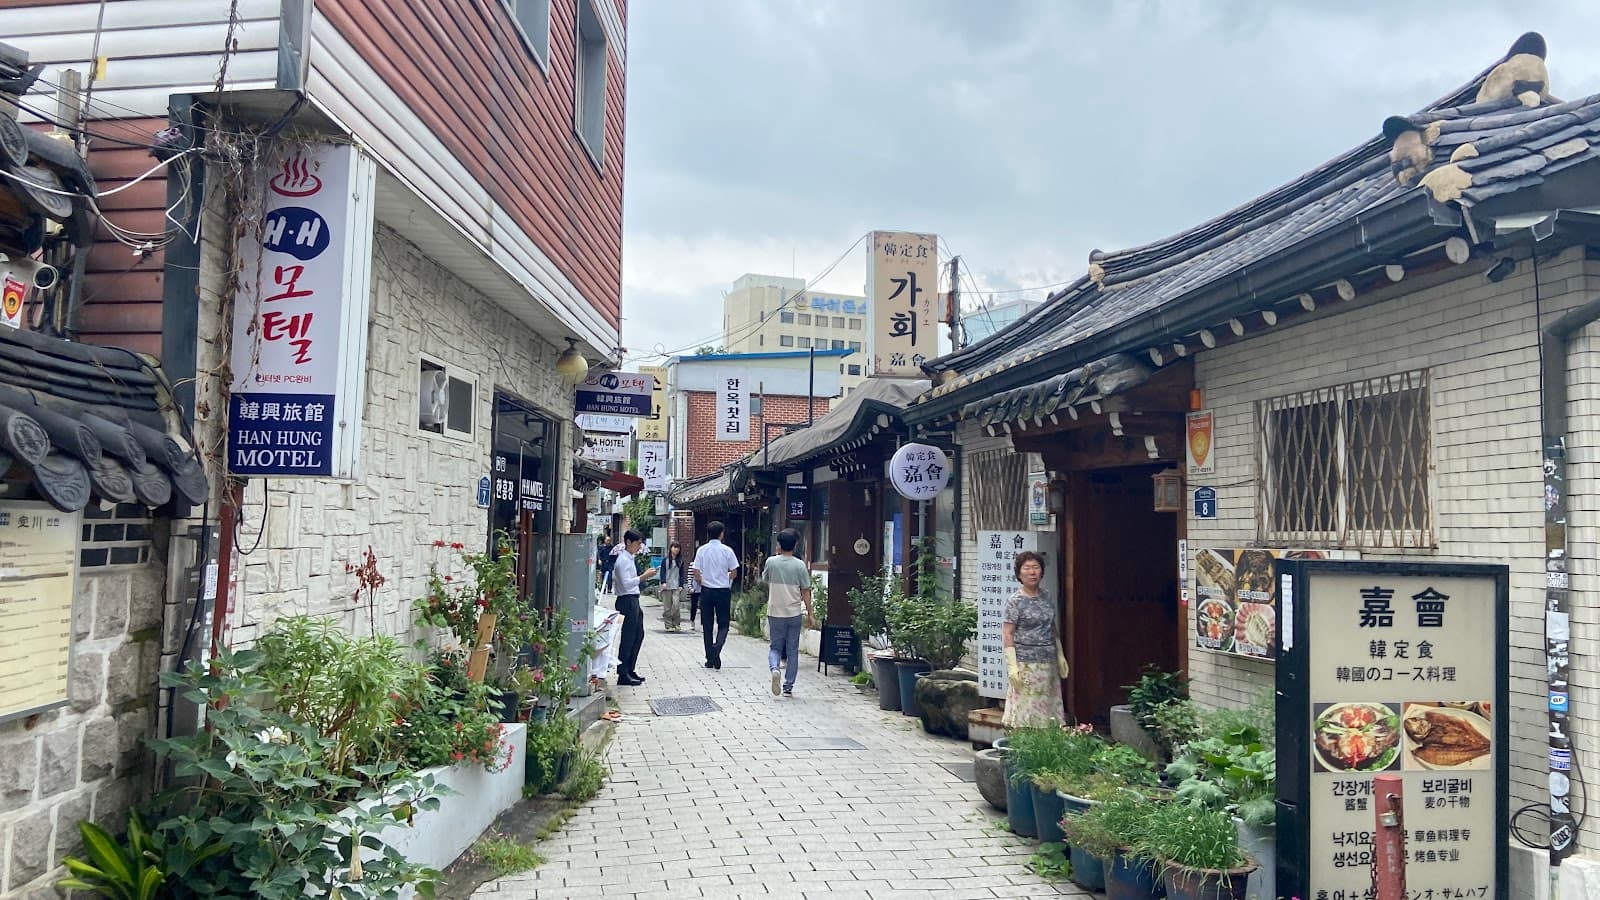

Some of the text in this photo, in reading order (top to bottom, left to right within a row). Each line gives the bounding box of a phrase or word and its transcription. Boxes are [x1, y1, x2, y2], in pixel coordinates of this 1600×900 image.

[263, 265, 314, 365] 모텔
[888, 271, 923, 347] 가회
[620, 378, 645, 392] 모텔
[239, 401, 325, 422] 韓興旅館
[586, 403, 641, 414] HAN HUNG MOTEL
[726, 378, 741, 433] 한옥찻집
[238, 430, 323, 446] HAN HUNG
[599, 438, 625, 448] HOSTEL
[236, 449, 322, 468] MOTEL
[643, 451, 657, 480] 귀천
[900, 463, 944, 484] 嘉會
[1202, 502, 1208, 515] 8
[1359, 586, 1450, 628] 嘉會
[1369, 639, 1434, 659] 韓定食
[1336, 665, 1457, 682] 韓國のコース料理
[1332, 780, 1376, 796] 간장게
[1421, 778, 1472, 794] 보리굴비
[1424, 796, 1470, 809] 麦の干物
[1414, 829, 1471, 843] 章鱼料理专
[1414, 848, 1460, 863] 烤鱼专业
